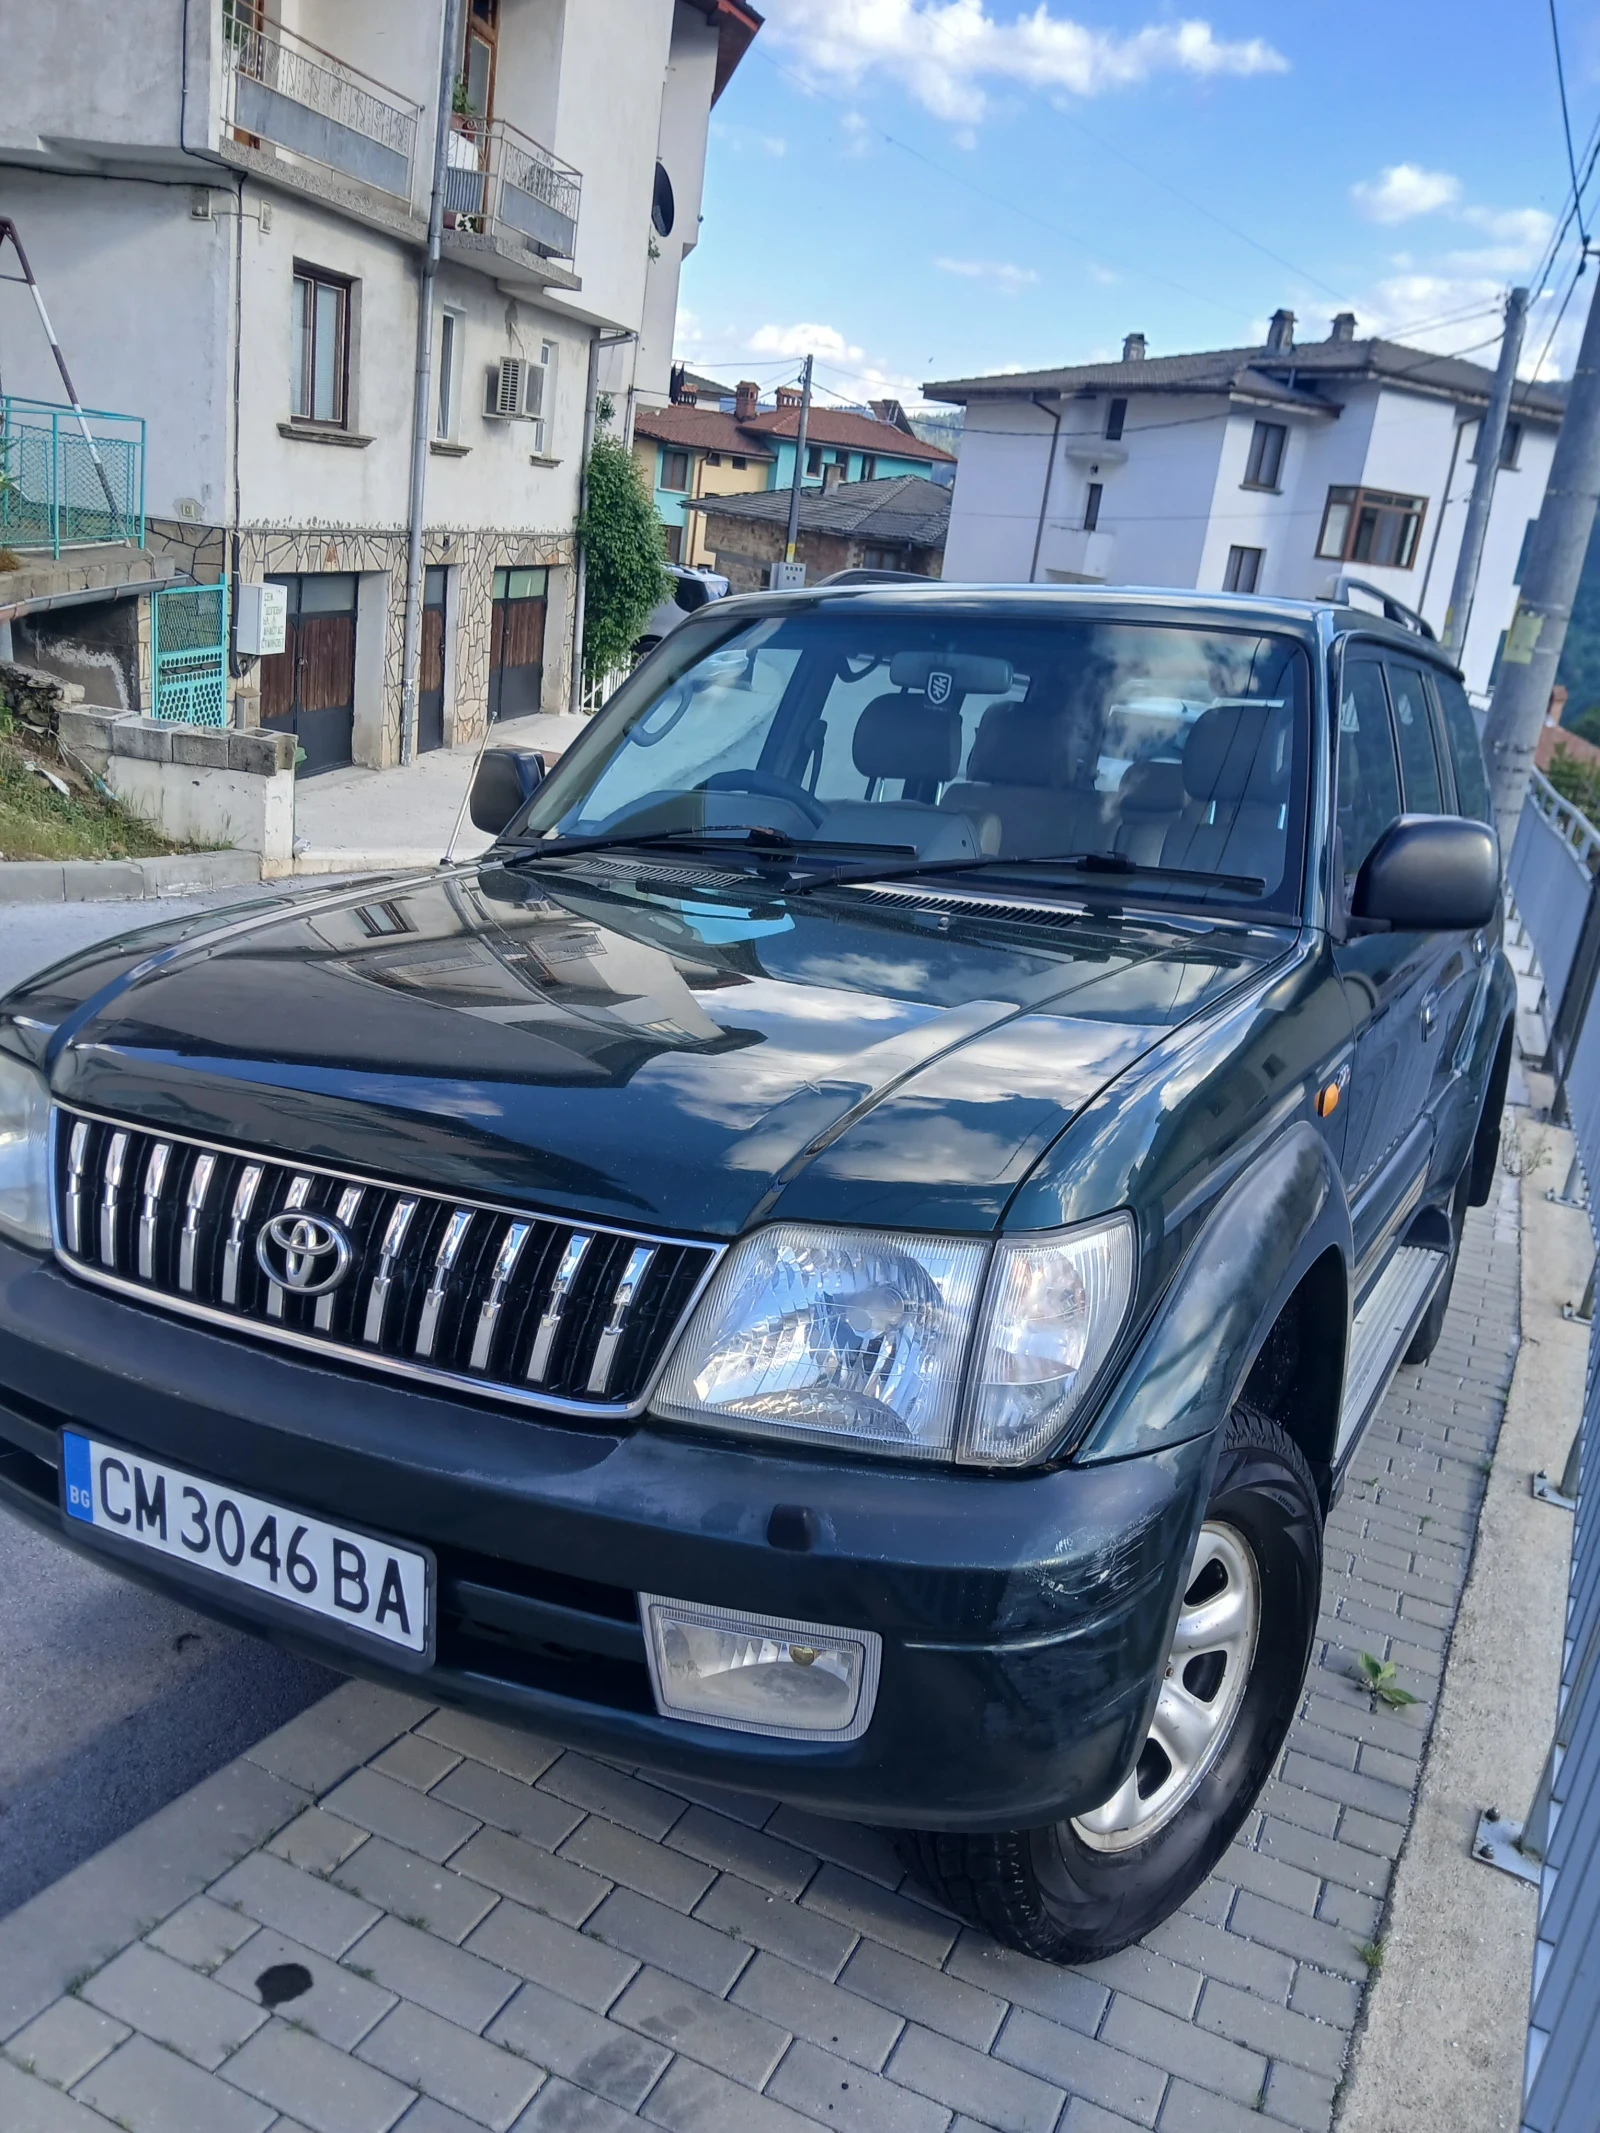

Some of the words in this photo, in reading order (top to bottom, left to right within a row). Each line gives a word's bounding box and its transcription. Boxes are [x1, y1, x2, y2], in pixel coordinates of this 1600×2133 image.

[69, 1484, 91, 1509] BG
[100, 1456, 168, 1541] CM
[181, 1485, 318, 1594] 3046
[332, 1537, 411, 1635] BA
